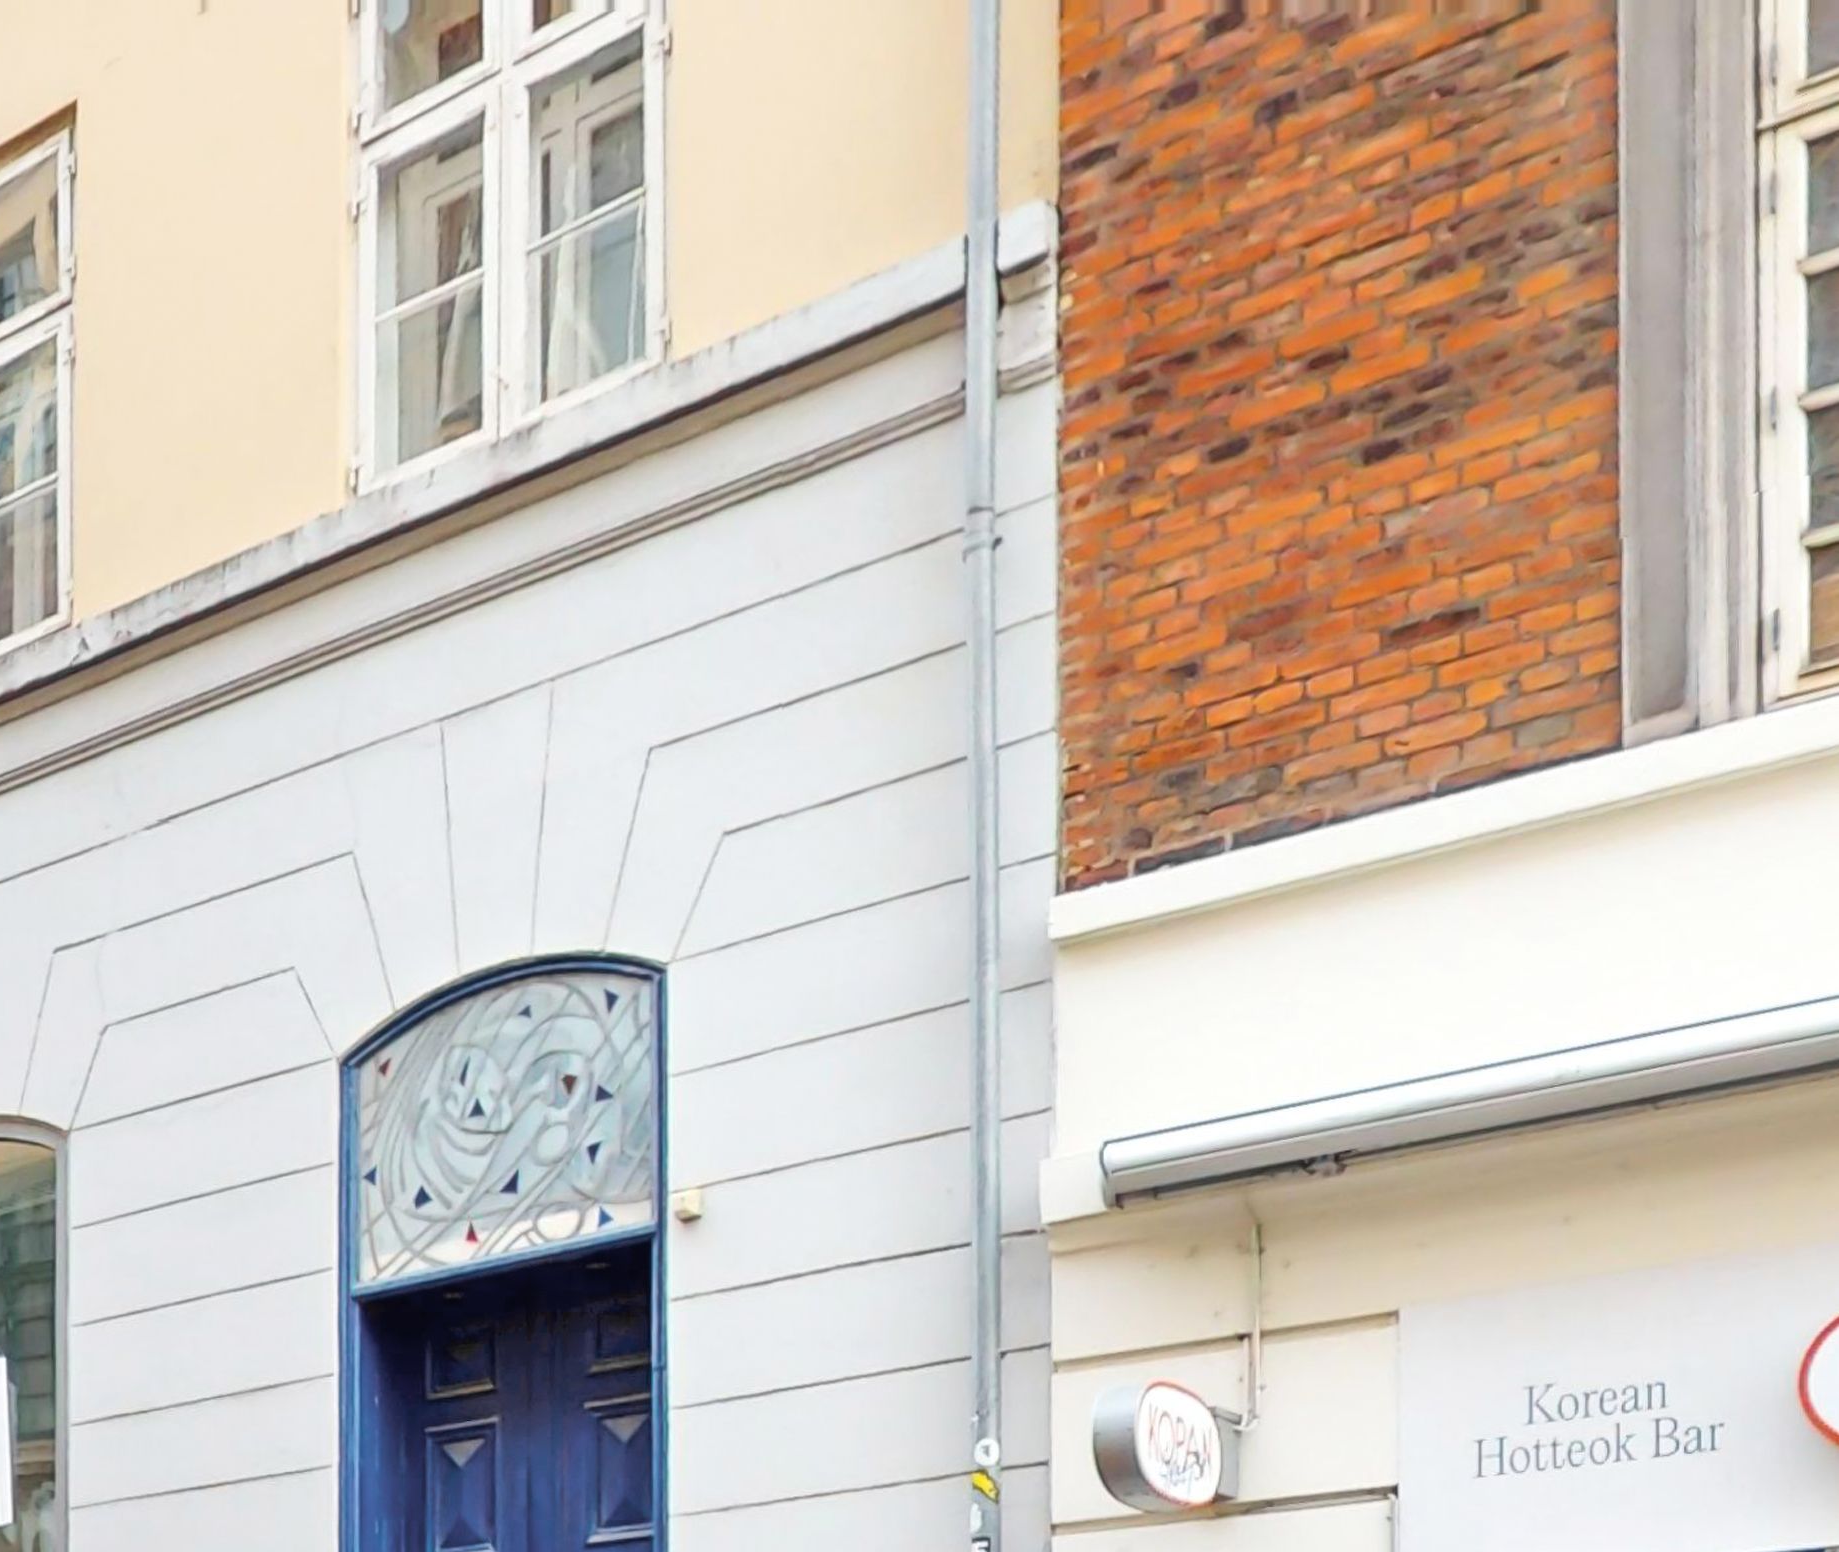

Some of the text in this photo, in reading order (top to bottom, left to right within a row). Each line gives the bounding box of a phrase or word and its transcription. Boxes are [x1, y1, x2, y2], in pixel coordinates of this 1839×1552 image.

[1524, 1380, 1669, 1426] Korean
[1148, 1403, 1212, 1468] KOPAN
[1473, 1417, 1725, 1478] Hotteok Bar
